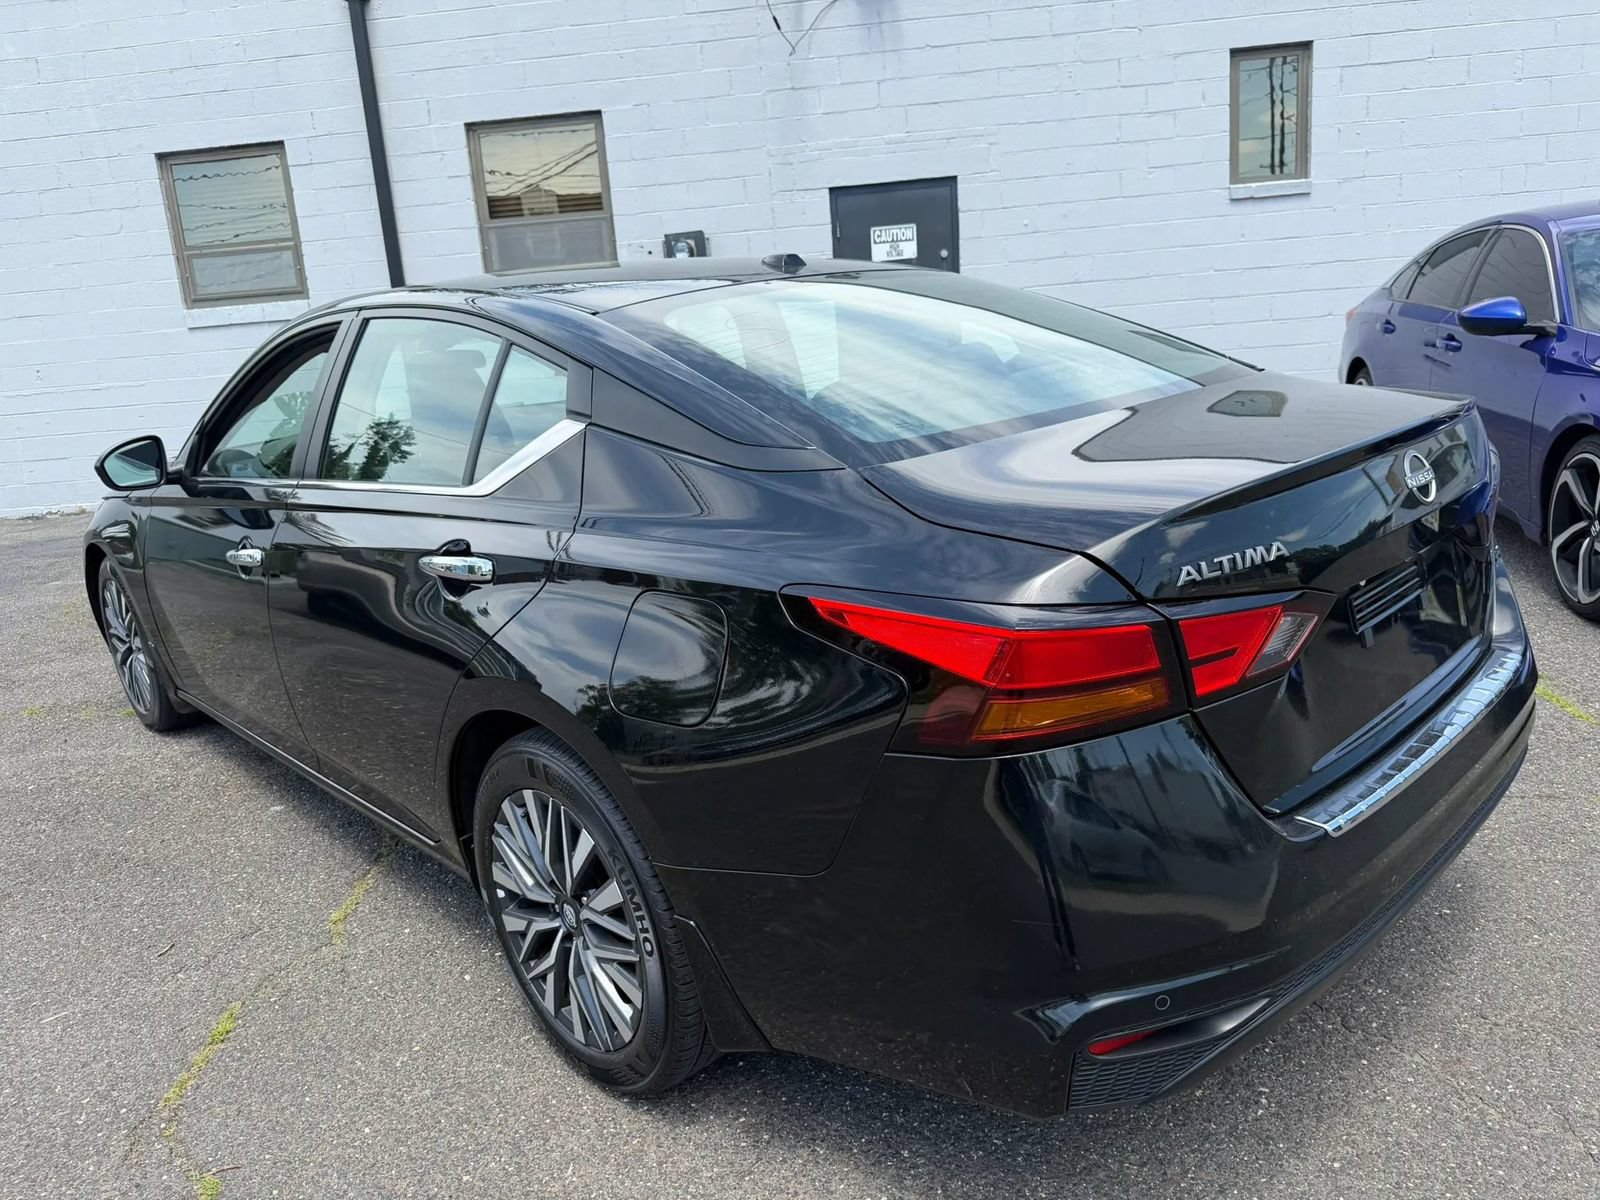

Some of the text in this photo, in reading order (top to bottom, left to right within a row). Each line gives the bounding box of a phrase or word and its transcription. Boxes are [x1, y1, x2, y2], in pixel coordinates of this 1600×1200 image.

[874, 227, 913, 243] CAUTION
[1407, 470, 1434, 487] NISSA
[1176, 541, 1291, 588] ALTIMA
[608, 848, 655, 958] KUMHO
